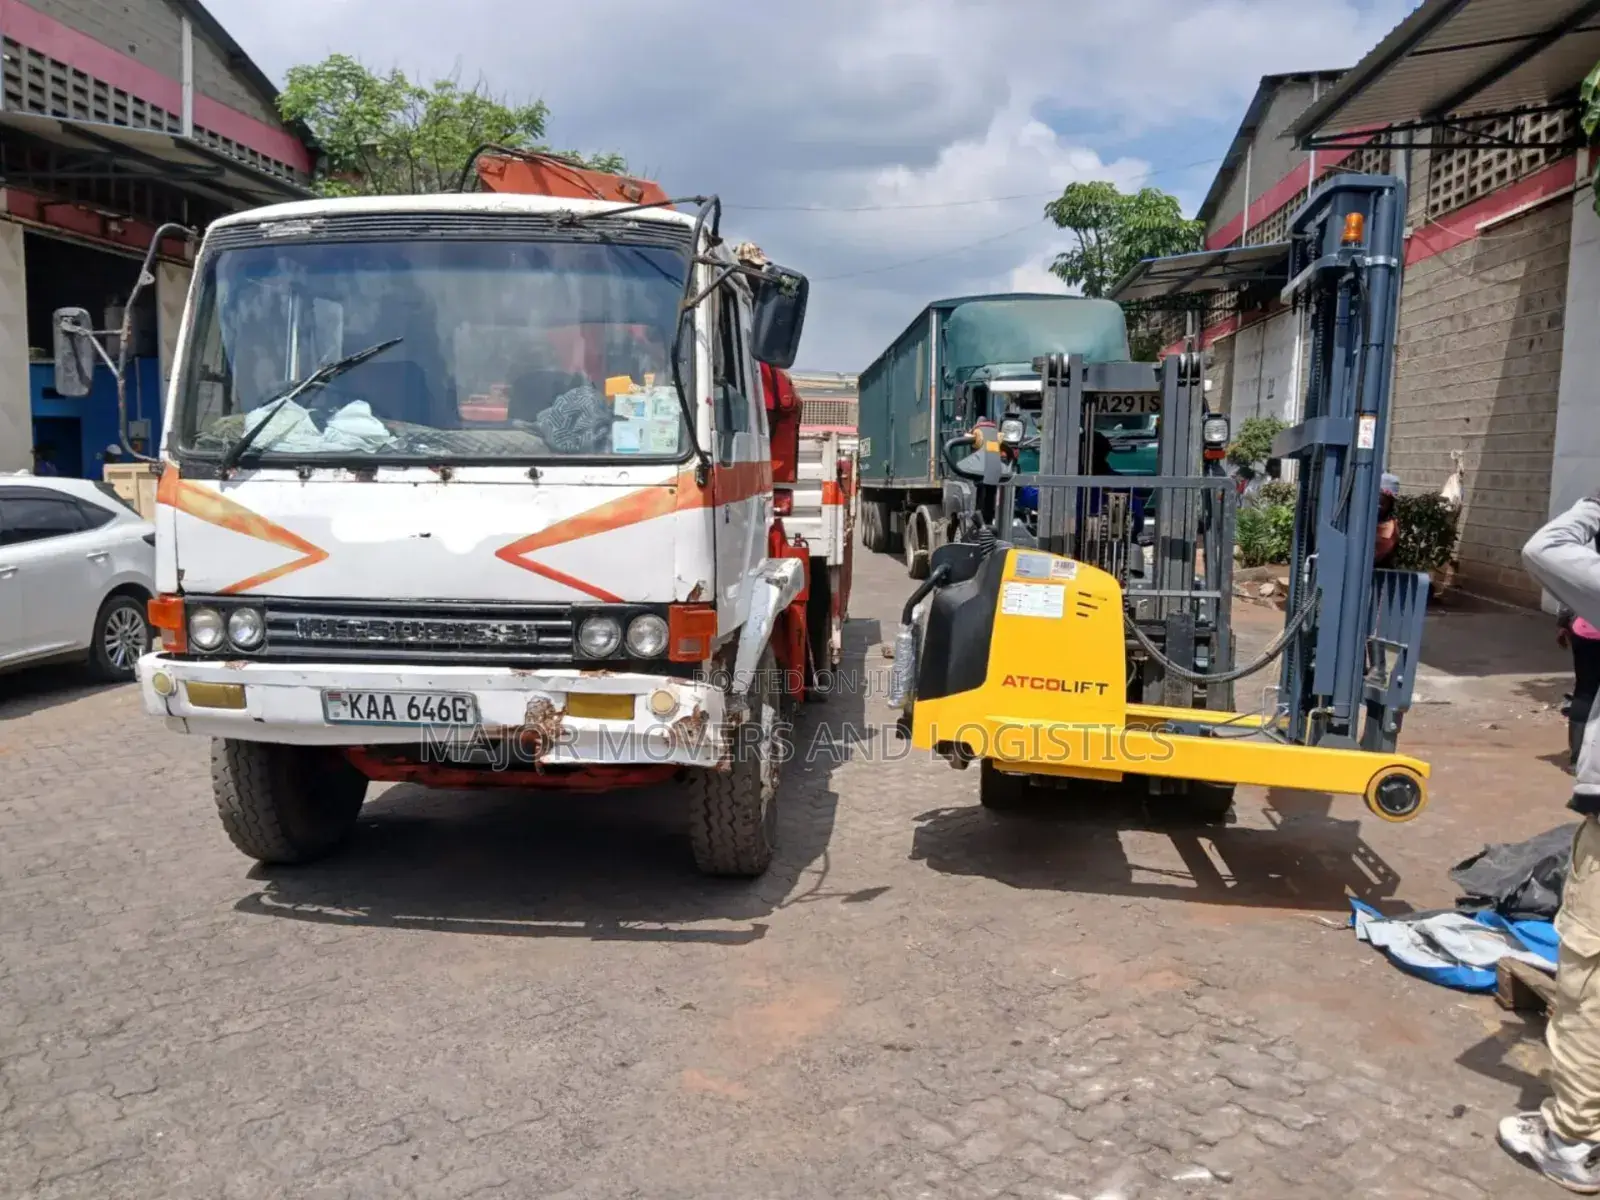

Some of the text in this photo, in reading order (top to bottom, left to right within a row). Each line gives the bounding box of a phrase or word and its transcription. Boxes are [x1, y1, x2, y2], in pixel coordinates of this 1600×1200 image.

[1001, 674, 1109, 696] ATCOLIFT
[349, 693, 468, 722] KAA 646G
